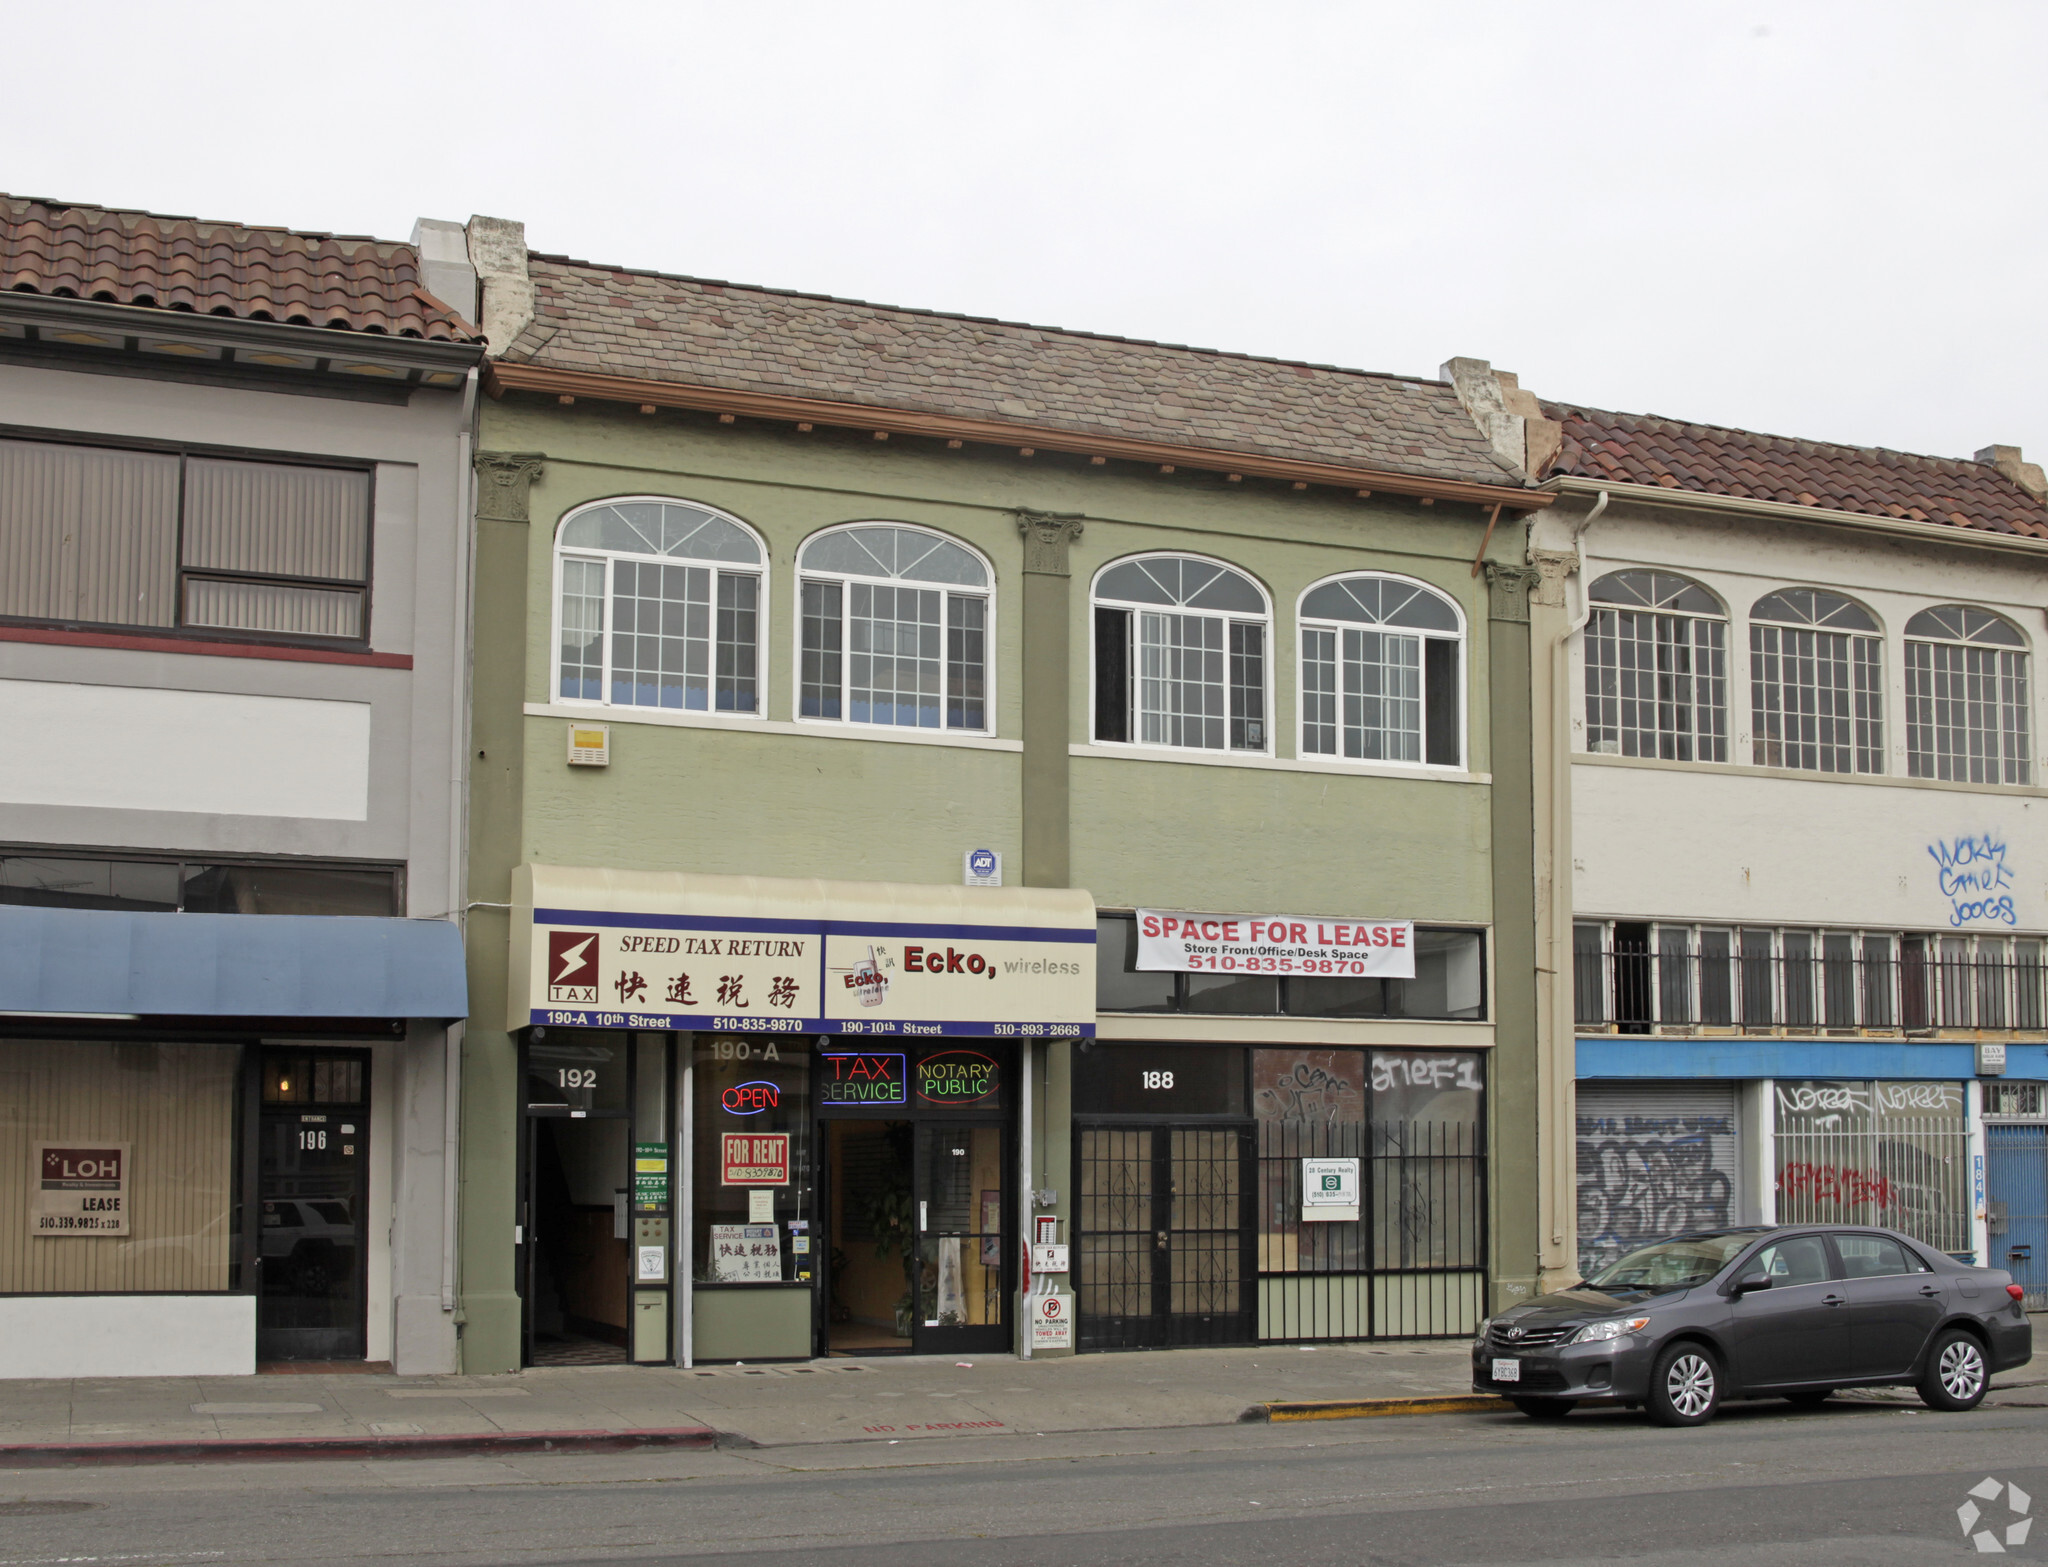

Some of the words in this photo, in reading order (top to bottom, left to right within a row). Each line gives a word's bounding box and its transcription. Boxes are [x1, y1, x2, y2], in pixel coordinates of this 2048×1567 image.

[974, 857, 992, 867] ADT
[1142, 916, 1240, 942] SPACE
[1250, 921, 1308, 944] FOR
[1317, 925, 1407, 948] LEASE
[620, 935, 680, 954] SPEED
[684, 938, 723, 955] TAX
[727, 940, 805, 957] RETURN
[1184, 943, 1218, 955] Store
[1221, 945, 1328, 959] Front/Office/Desk
[1331, 949, 1369, 961] Space
[904, 945, 996, 980] Ecko,
[1004, 958, 1080, 975] wireless
[1187, 956, 1365, 975] 510-835-9870
[552, 986, 594, 1001] TAX
[547, 1012, 588, 1025] 190-A
[595, 1013, 624, 1026] 10th
[628, 1014, 671, 1028] Street
[713, 1018, 802, 1031] 510-835-9870
[841, 1021, 895, 1034] 190-10th
[903, 1023, 942, 1034] Street
[994, 1024, 1080, 1036] 510-893-2668
[711, 1042, 779, 1061] 190-A
[827, 1057, 891, 1080] TAX
[918, 1063, 993, 1079] NOTARY
[558, 1068, 597, 1088] 192
[1142, 1071, 1174, 1090] 188
[822, 1082, 901, 1100] SERVICE
[925, 1079, 988, 1095] PUBLIC
[722, 1087, 778, 1108] OPEN
[299, 1130, 326, 1150] 196
[727, 1139, 749, 1164] FOR
[753, 1139, 784, 1164] RENT
[63, 1160, 117, 1177] LOH
[82, 1198, 120, 1211] LEASE
[40, 1217, 99, 1229] 510.339.9825
[107, 1220, 120, 1229] 228
[720, 1226, 735, 1234] TAX
[863, 1425, 896, 1433] NO
[906, 1420, 1005, 1431] PARKING
